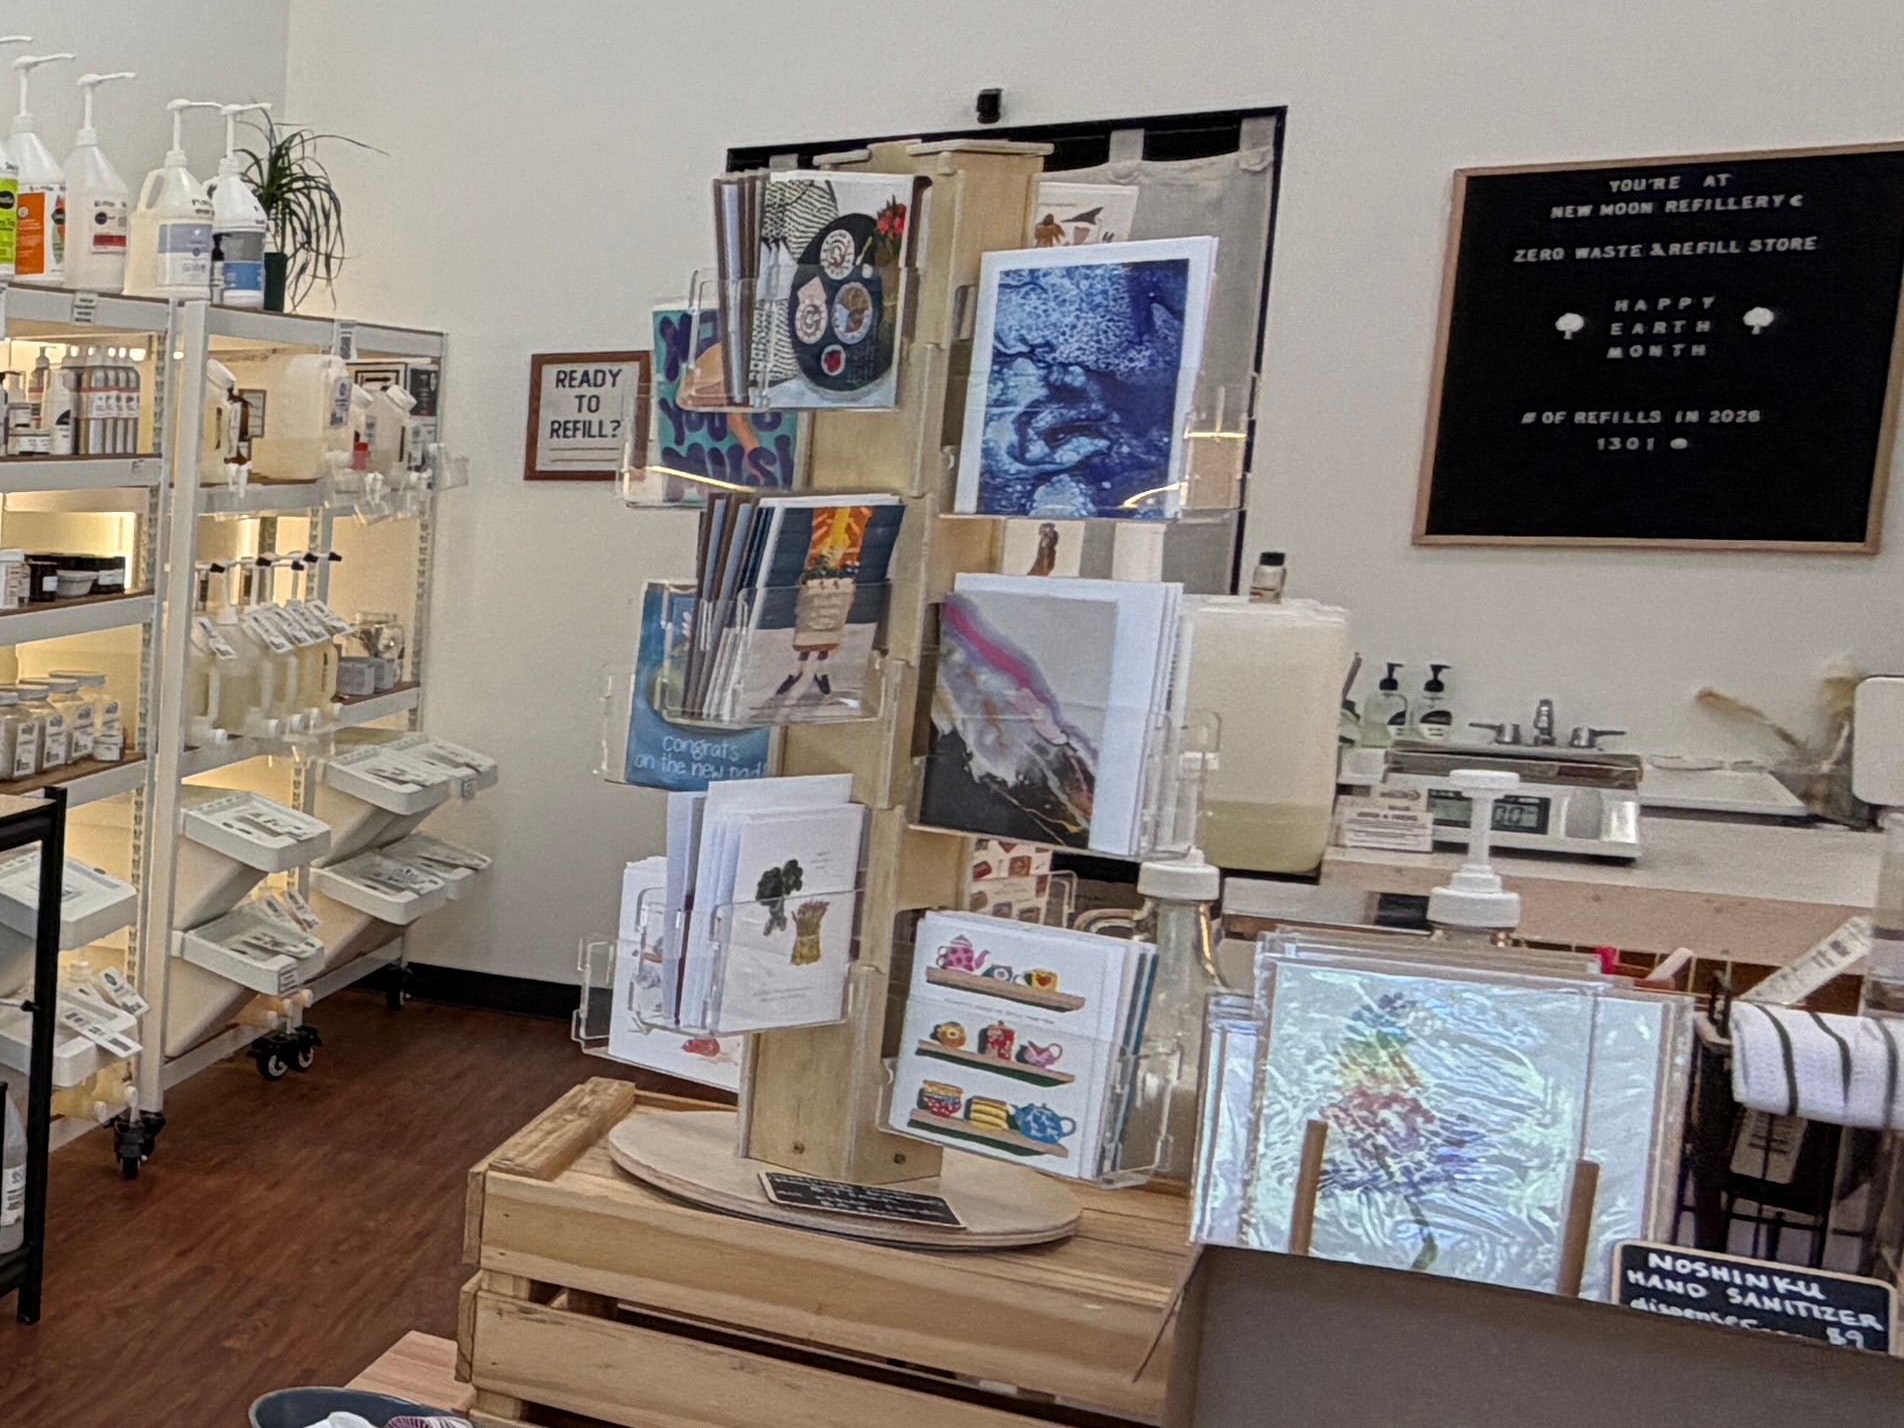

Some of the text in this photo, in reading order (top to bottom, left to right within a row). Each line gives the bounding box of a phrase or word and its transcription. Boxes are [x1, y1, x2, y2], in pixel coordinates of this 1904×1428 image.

[1703, 173, 1732, 188] AT
[1550, 193, 1785, 219] NEW MOON REFILLERY
[1513, 246, 1565, 263] ZERO
[1574, 242, 1643, 260] WASTE
[1669, 239, 1741, 256] REFILL
[1748, 236, 1819, 253] STORE
[1614, 295, 1715, 313] HAPPY
[1610, 320, 1711, 336] EARTH
[1606, 343, 1707, 359] MONTH
[554, 366, 623, 391] READY
[575, 395, 602, 415] TO
[1542, 411, 1567, 424] OF
[1573, 410, 1662, 424] REFILLS
[1675, 410, 1700, 424] IN
[548, 417, 624, 442] REFILL?
[1597, 437, 1656, 451] 1301
[662, 734, 740, 762] congrats
[635, 758, 655, 773] on
[659, 753, 688, 775] the
[690, 758, 725, 778] new
[1648, 1250, 1825, 1300] NOSHINKU
[1627, 1268, 1882, 1332] HAND SANITIZER
